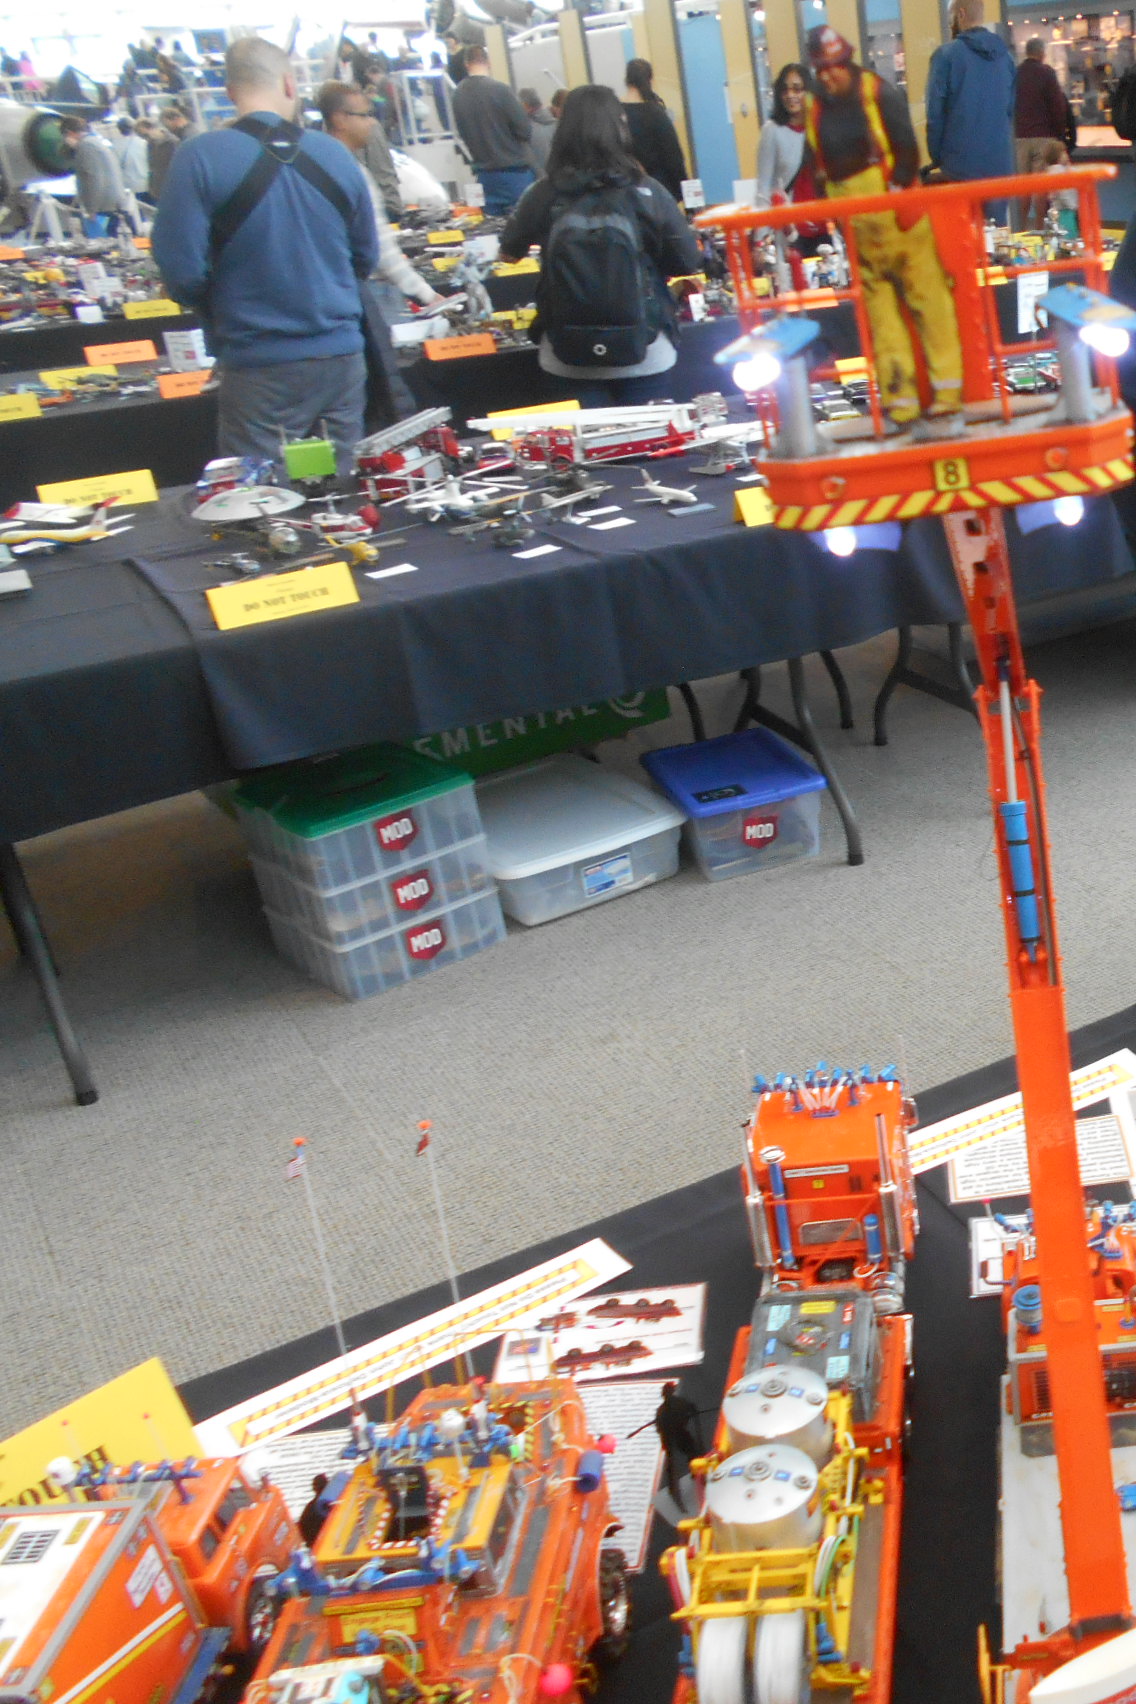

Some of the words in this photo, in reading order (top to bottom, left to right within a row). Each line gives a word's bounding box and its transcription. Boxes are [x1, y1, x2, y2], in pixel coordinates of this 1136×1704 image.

[944, 461, 960, 486] 8
[243, 602, 260, 612] DO
[264, 596, 287, 608] NOT
[290, 587, 330, 602] TOUCH
[380, 818, 413, 844] MOD
[746, 823, 774, 840] MOD
[396, 878, 430, 904] MOD
[410, 928, 442, 953] MOD
